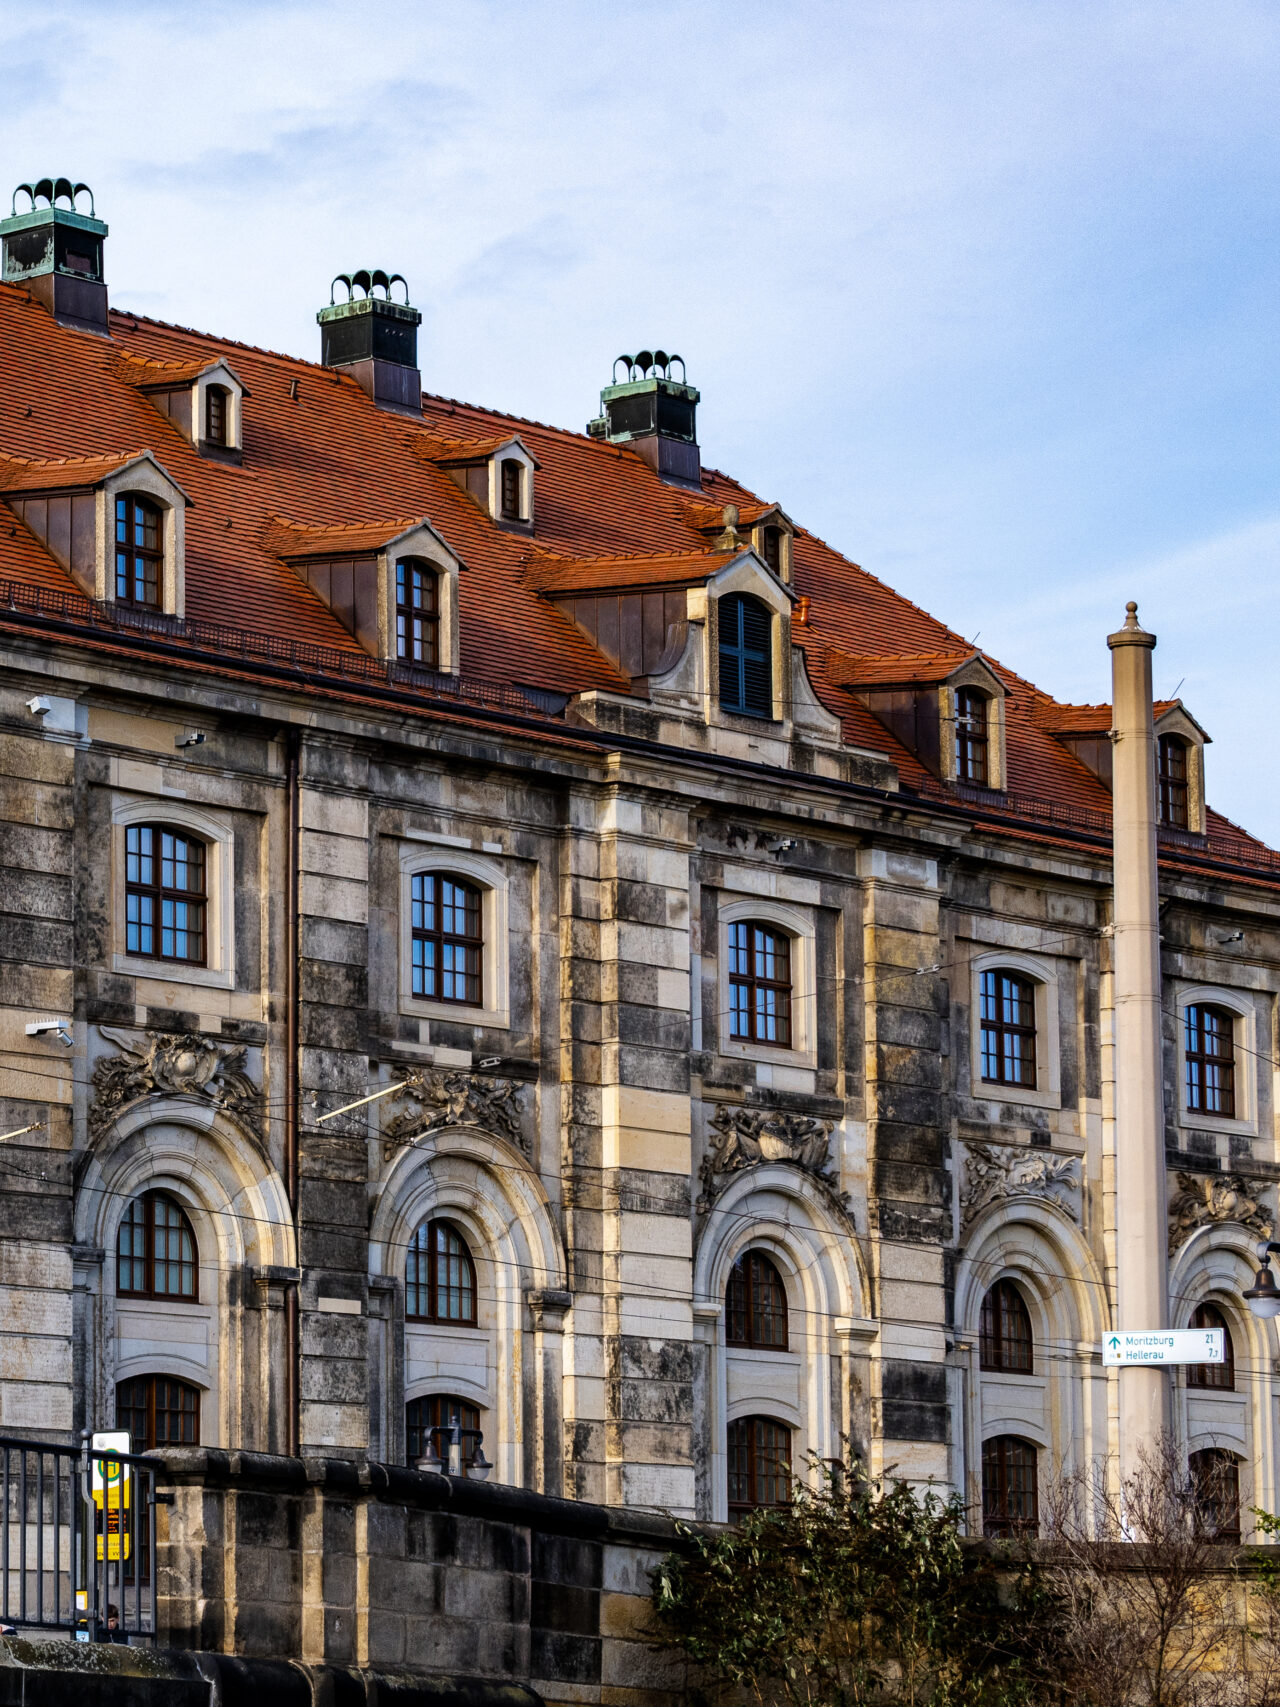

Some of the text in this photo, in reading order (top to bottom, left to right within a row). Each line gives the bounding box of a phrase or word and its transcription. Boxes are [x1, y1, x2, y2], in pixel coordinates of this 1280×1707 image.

[1126, 1334, 1214, 1347] Moritzburg 21
[1126, 1350, 1164, 1360] Hellerau
